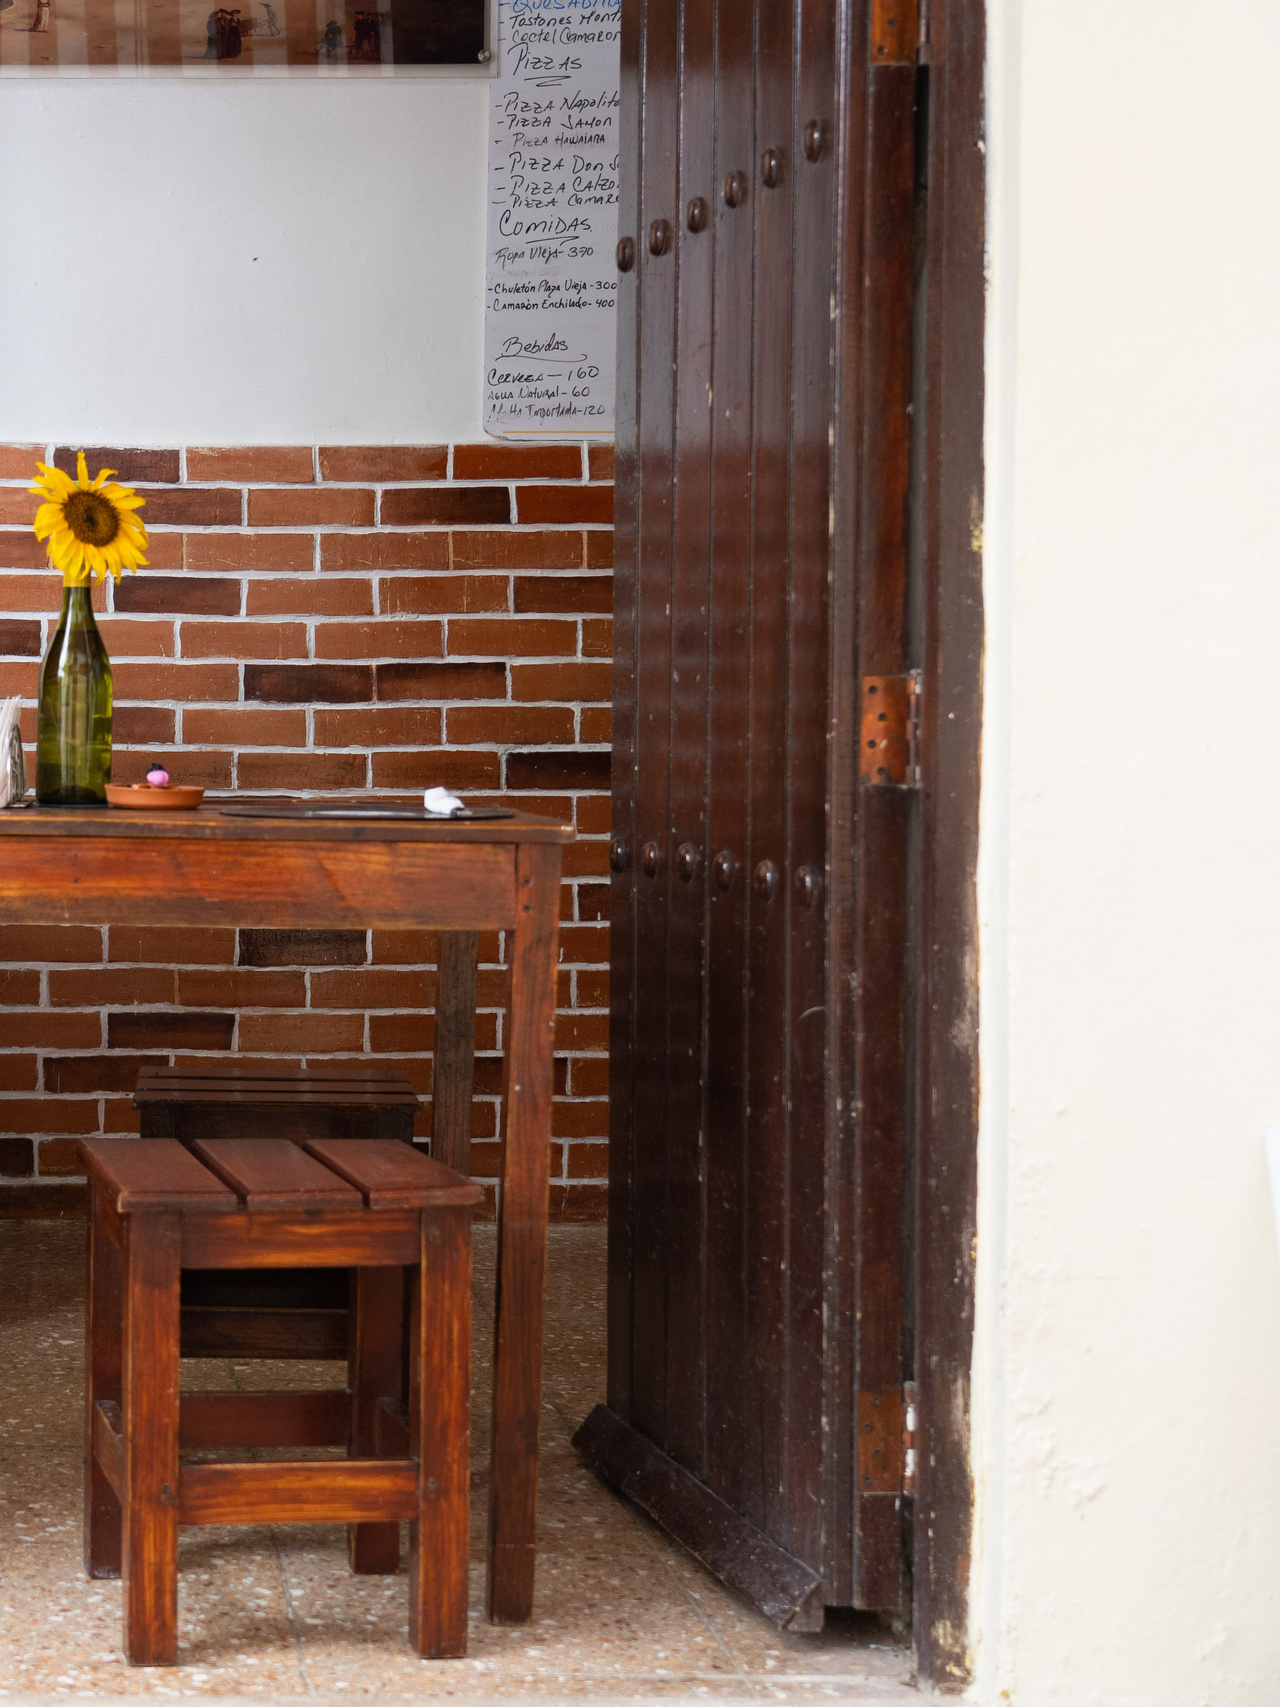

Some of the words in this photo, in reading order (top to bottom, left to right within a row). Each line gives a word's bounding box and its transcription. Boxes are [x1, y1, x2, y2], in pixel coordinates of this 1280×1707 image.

[572, 154, 604, 175] Don
[567, 246, 594, 258] 370
[595, 299, 615, 308] 400
[567, 366, 600, 381] 160
[571, 386, 590, 397] 60
